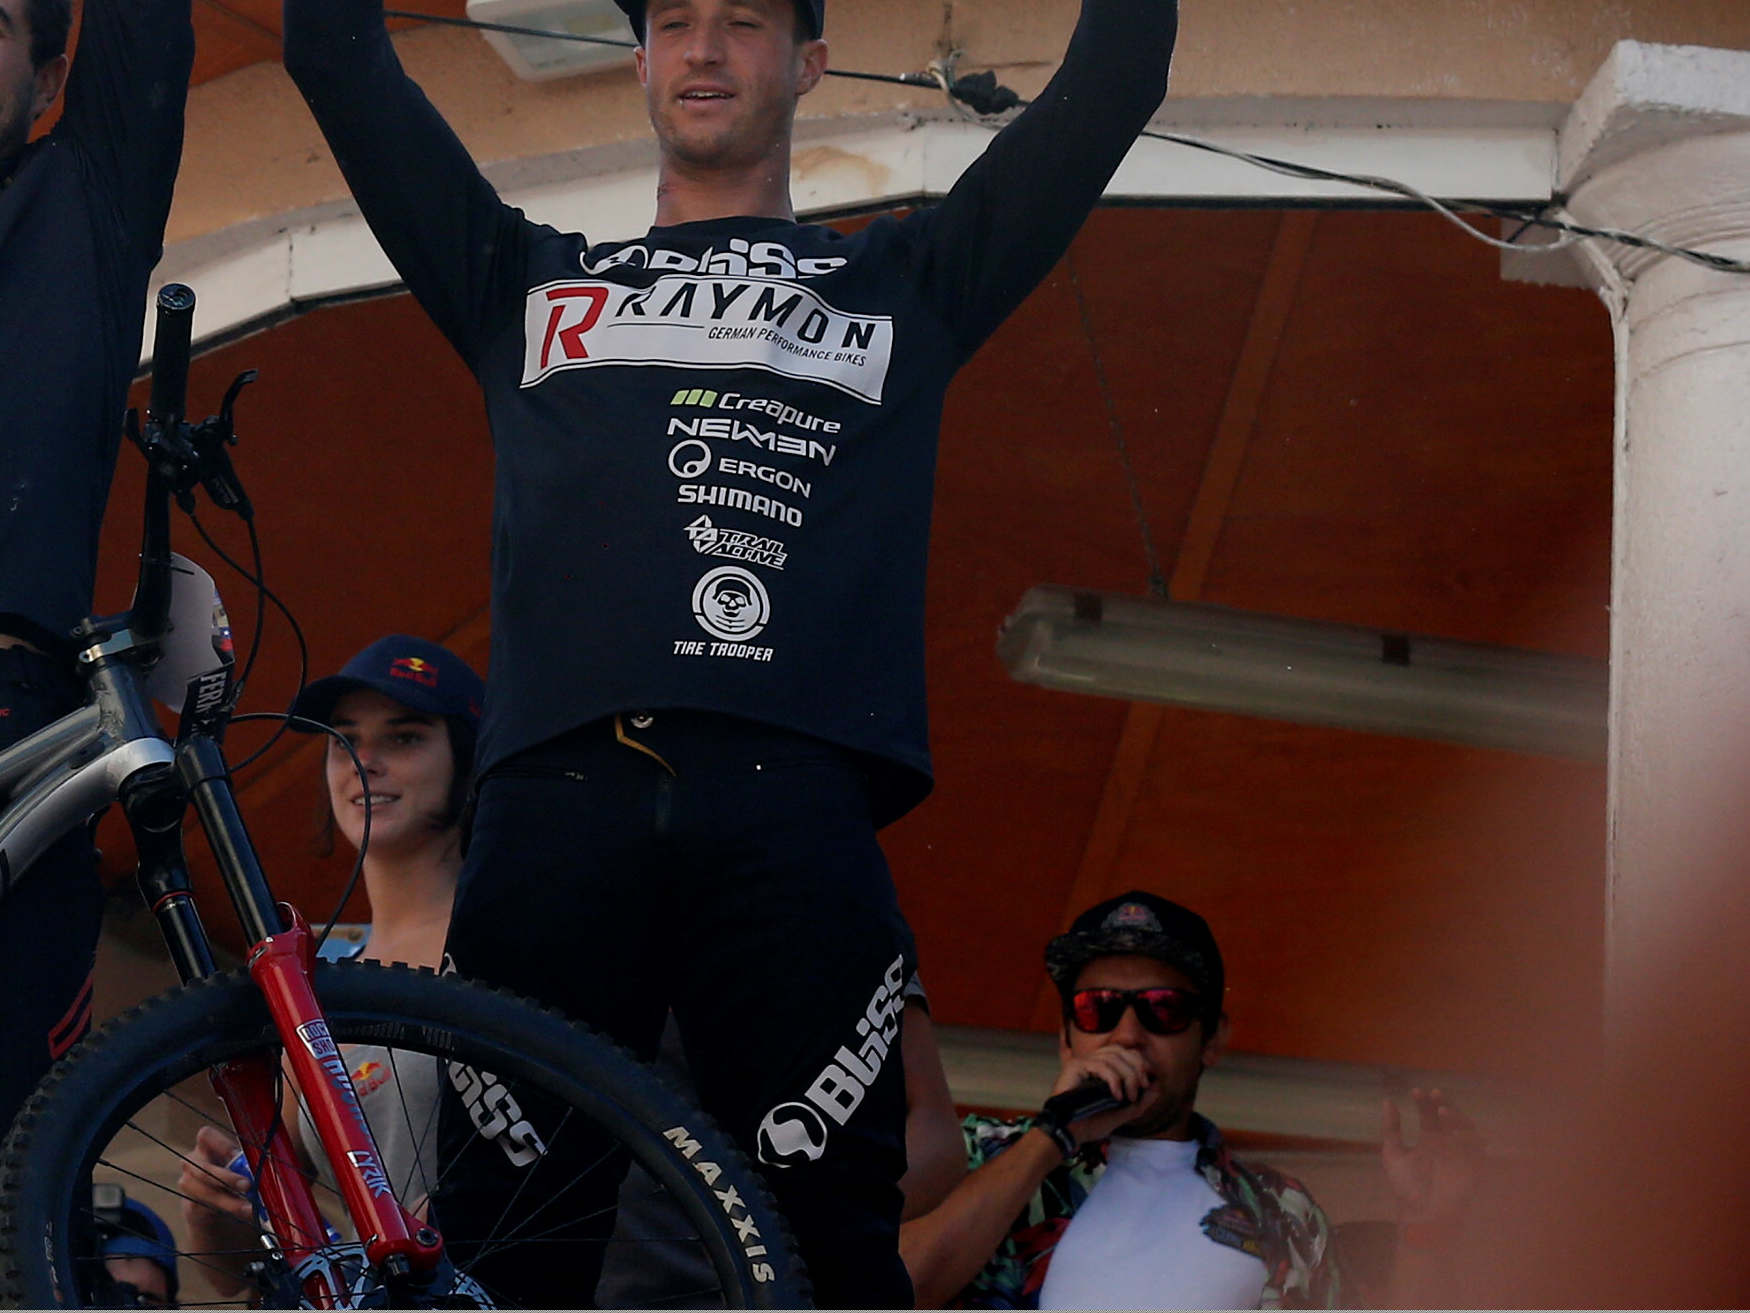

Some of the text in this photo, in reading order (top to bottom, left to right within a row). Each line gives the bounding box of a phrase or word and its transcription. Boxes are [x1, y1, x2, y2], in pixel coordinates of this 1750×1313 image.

[614, 283, 877, 351] RAYMON
[707, 326, 867, 368] GERMAN PERFORMANCE BIKES
[718, 392, 842, 434] Creapure
[718, 457, 812, 499] ERGON
[677, 484, 803, 528] SHIMANO
[673, 641, 774, 662] TIRE TROOPER
[662, 1126, 776, 1283] MAXXIS
